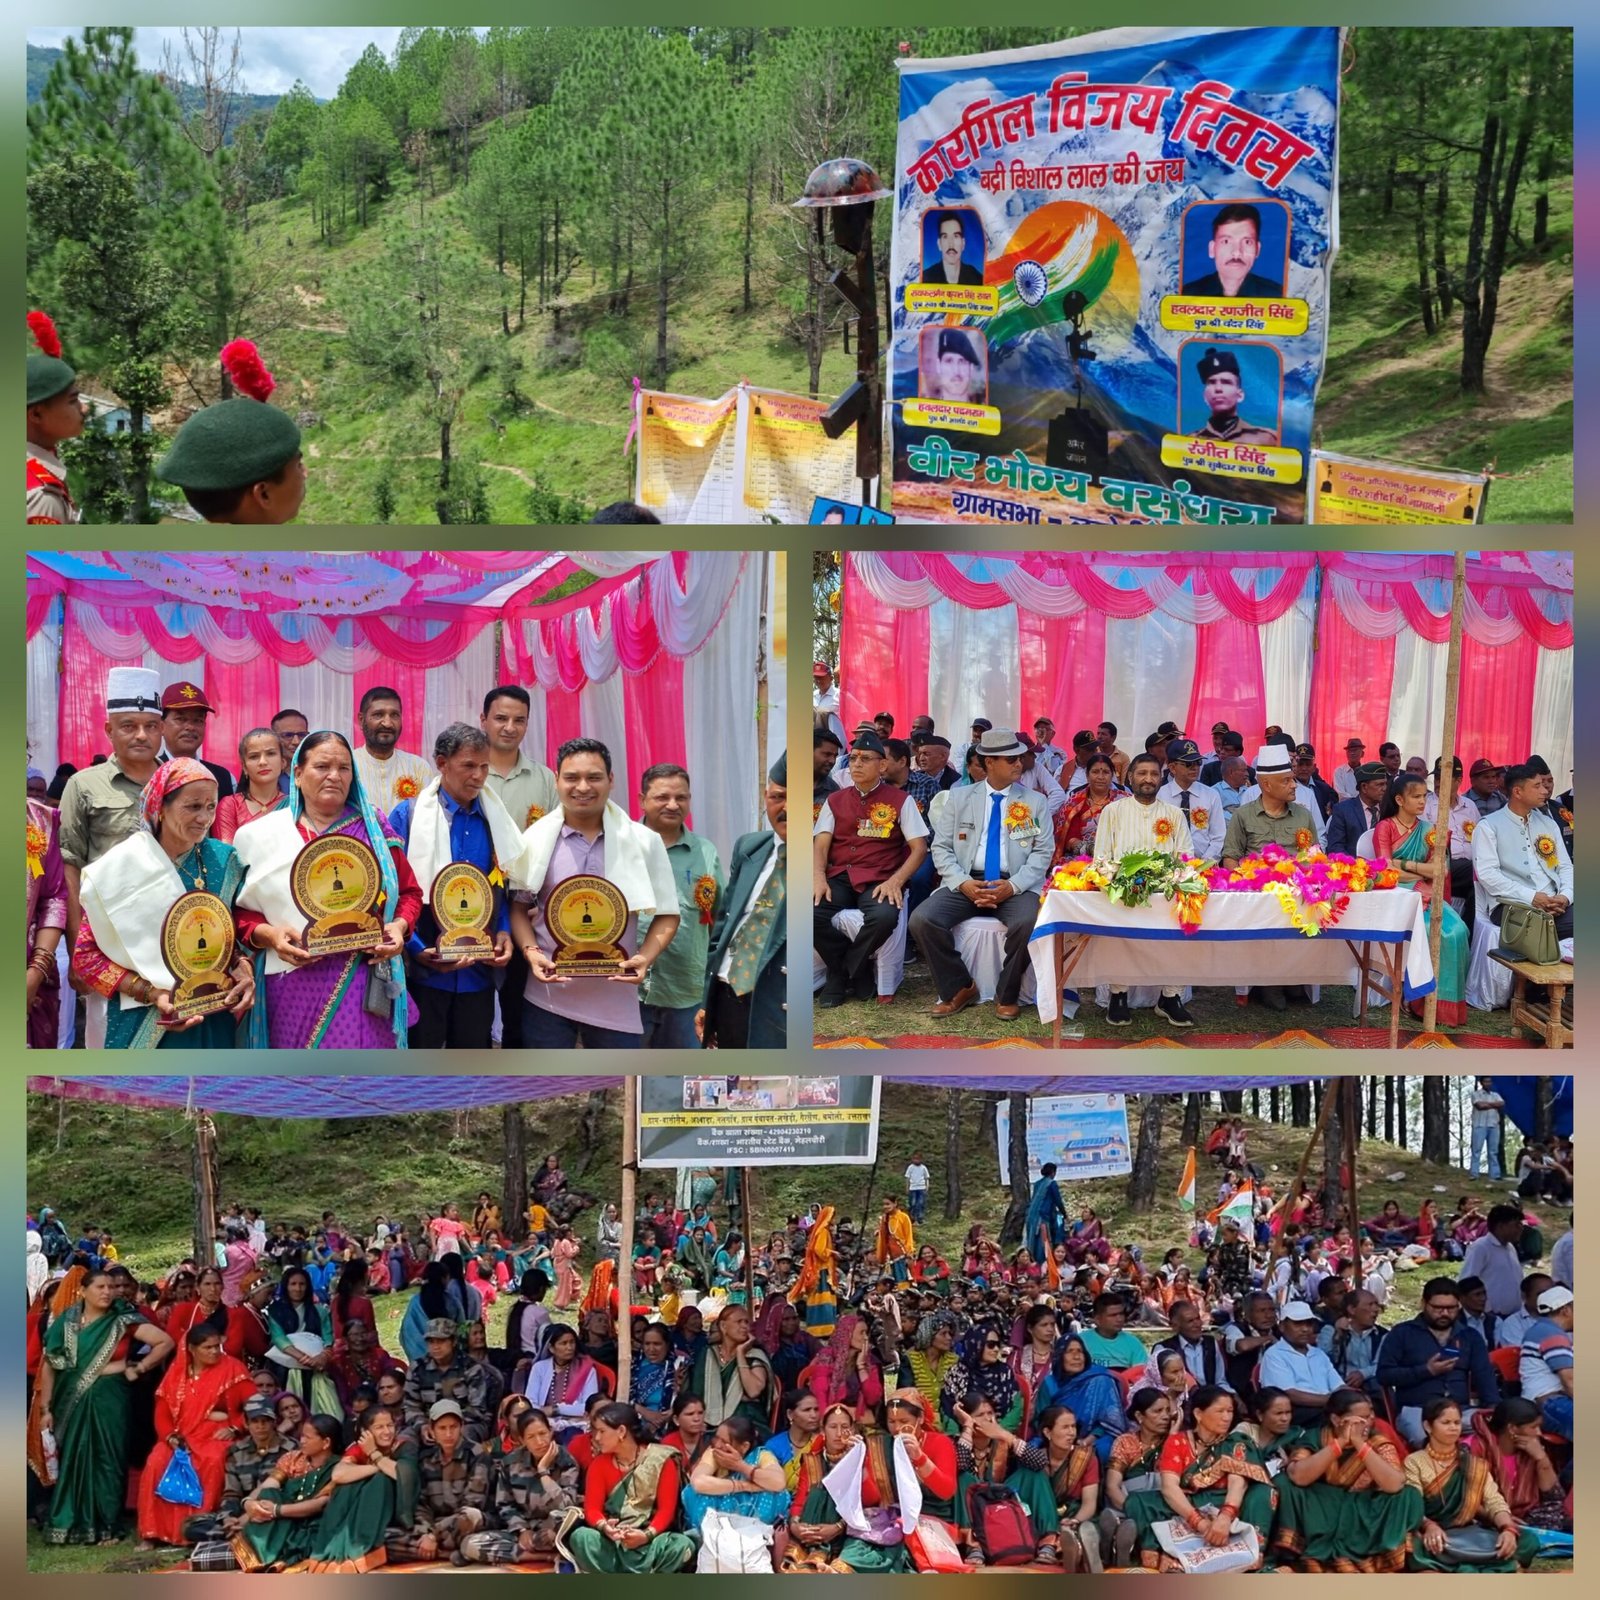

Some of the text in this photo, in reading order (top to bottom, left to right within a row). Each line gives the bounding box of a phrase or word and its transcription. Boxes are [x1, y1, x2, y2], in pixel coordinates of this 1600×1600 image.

[905, 71, 1316, 197] कारगिल विजय दिवस
[980, 151, 1186, 197] बद्री विशाल लाल की जय
[1170, 303, 1295, 320] हवलदार रणजीत सिंह
[1194, 319, 1208, 330] पुत्र
[1209, 317, 1221, 328] श्री
[1246, 319, 1265, 330] सिंह
[918, 403, 952, 415] हवलदार
[1066, 439, 1085, 450] अमर
[1187, 440, 1268, 465] रंजीत सिंह
[906, 434, 980, 482] वीर
[985, 449, 1091, 504] भोग्य
[1182, 456, 1194, 467] पुत्र
[1195, 456, 1206, 467] श्री
[1257, 464, 1276, 477] सिंह
[1347, 485, 1362, 497] वीर
[1395, 493, 1408, 505] की
[950, 490, 1042, 524] ग्रामसभा
[726, 1146, 743, 1154] IFSC
